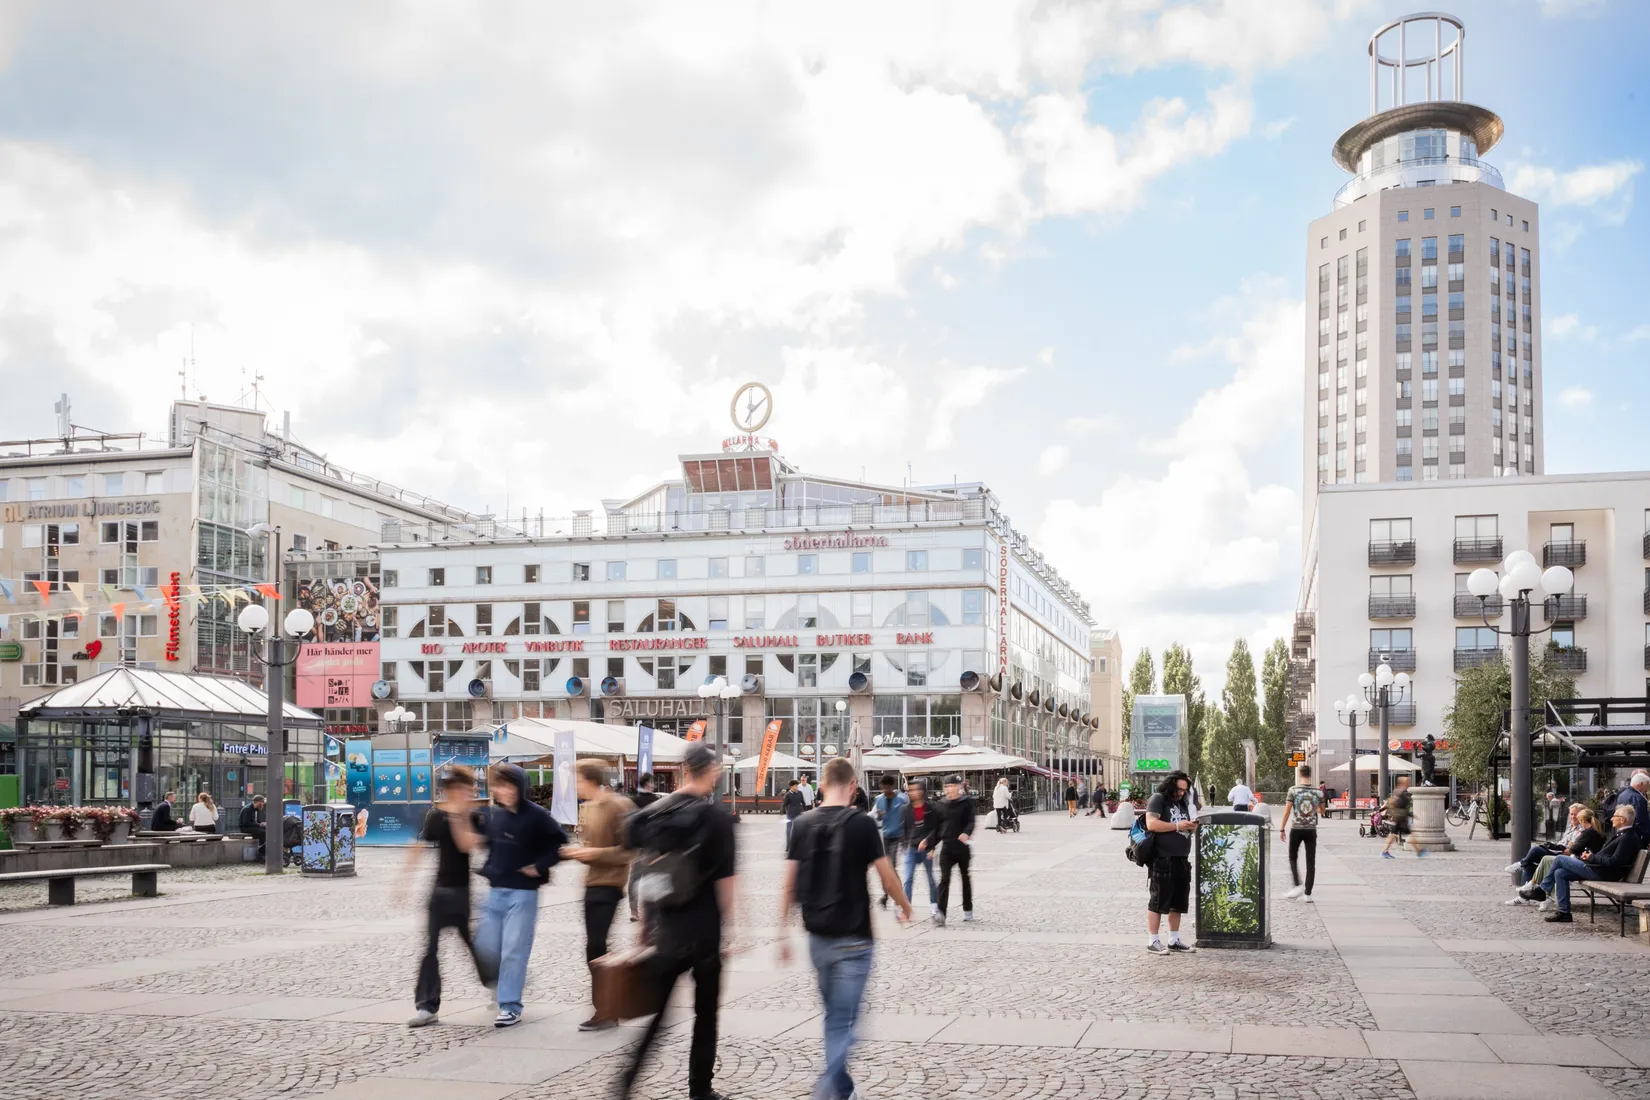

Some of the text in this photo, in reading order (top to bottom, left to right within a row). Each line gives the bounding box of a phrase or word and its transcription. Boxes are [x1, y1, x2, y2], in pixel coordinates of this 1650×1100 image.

[28, 503, 78, 520] ATRIUM
[82, 500, 160, 517] LJUNGBERG
[784, 532, 887, 550] söderhallarna
[307, 648, 322, 656] Här
[325, 647, 354, 655] händer
[421, 632, 934, 655] BIO APOTEK VINBUTIK RESTAURANGER SALUHALL BUTIKER BANK
[609, 699, 713, 717] SALUHALL
[224, 743, 268, 754] Entré P-hu
